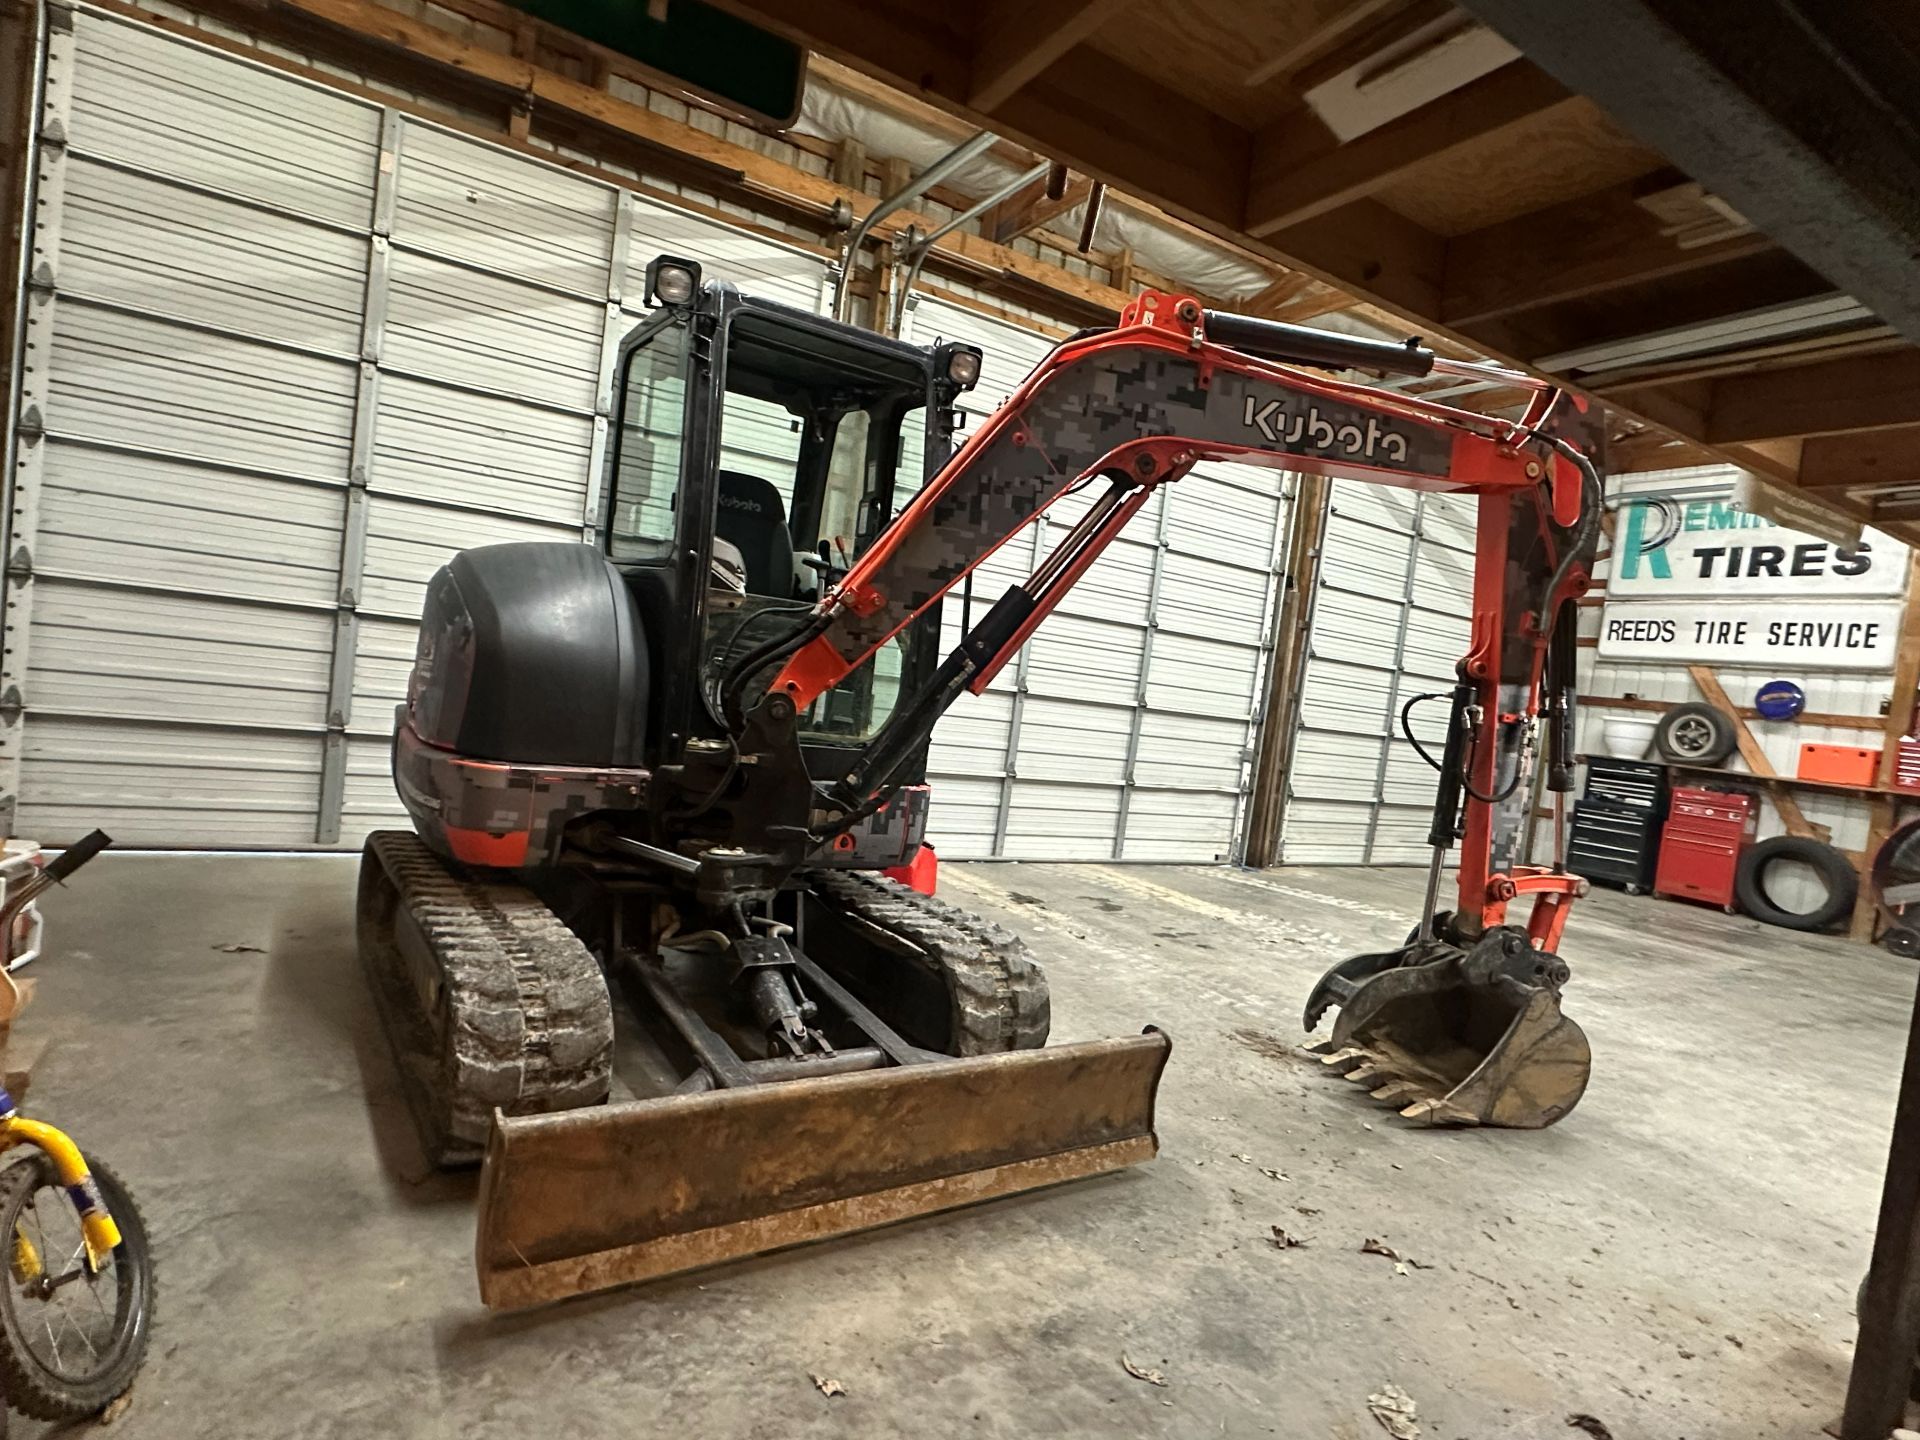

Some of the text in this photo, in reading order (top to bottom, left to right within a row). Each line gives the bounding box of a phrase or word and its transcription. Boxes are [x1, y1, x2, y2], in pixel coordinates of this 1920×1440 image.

[1243, 396, 1408, 463] Kubota
[1693, 542, 1872, 579] TIRES
[1694, 621, 1748, 645] TIRE
[1767, 622, 1880, 649] SERVICE
